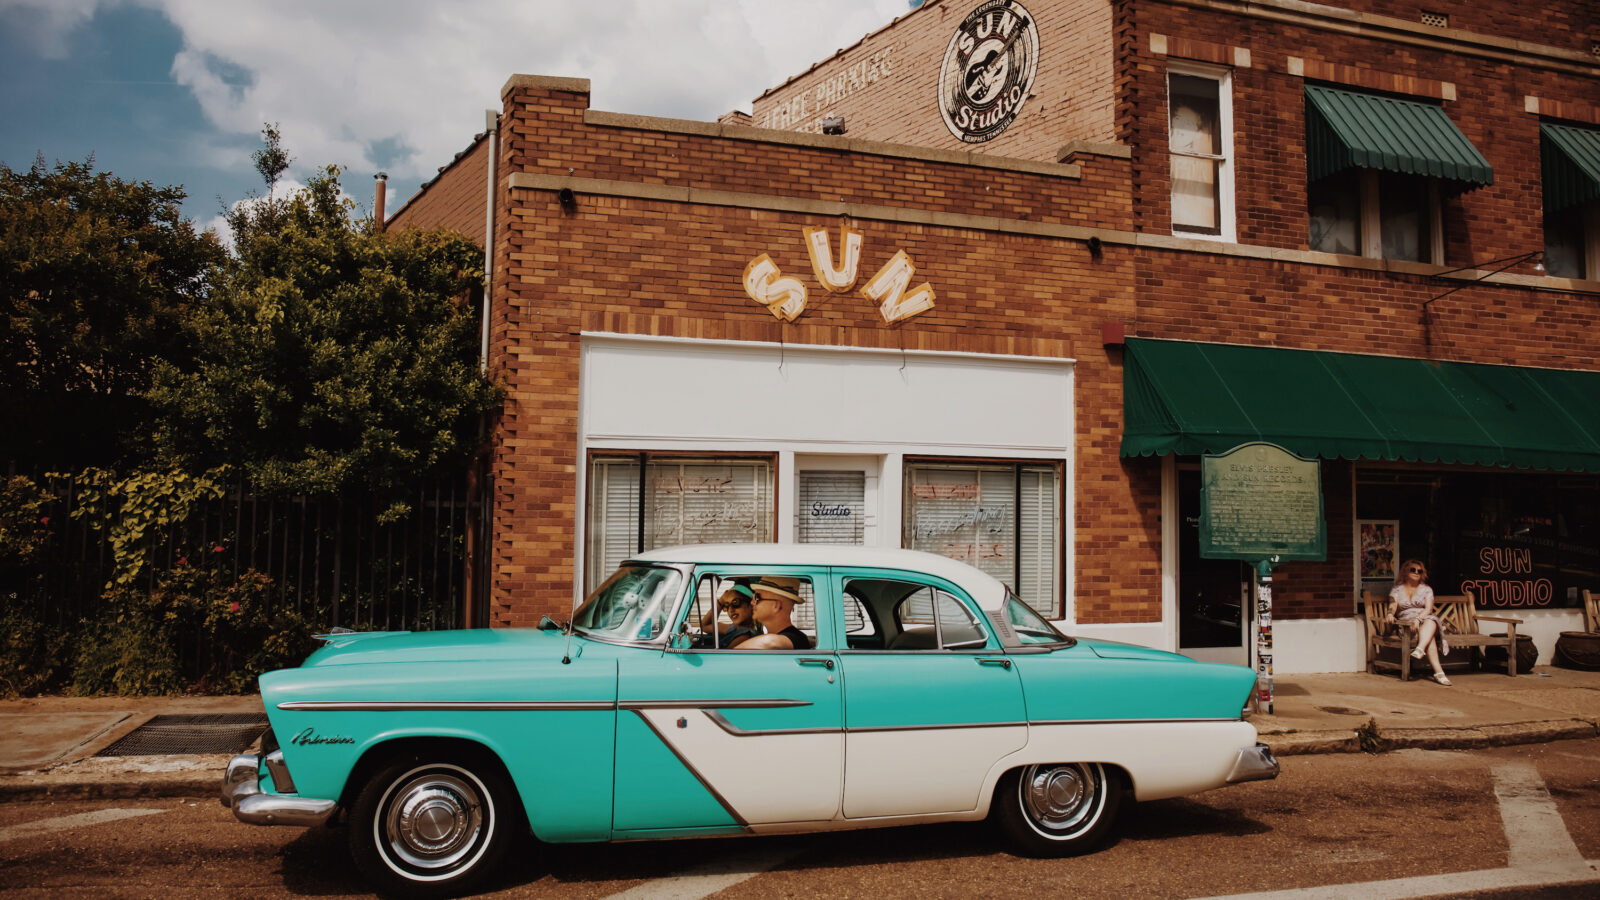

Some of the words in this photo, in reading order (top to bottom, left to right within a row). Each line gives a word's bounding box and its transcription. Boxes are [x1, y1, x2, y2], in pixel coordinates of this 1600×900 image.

[965, 12, 976, 23] THE
[959, 11, 1018, 55] SUN
[955, 85, 1021, 131] Studio
[742, 225, 937, 324] SUN
[811, 501, 852, 517] Studio
[1479, 547, 1532, 574] SUN
[1461, 578, 1553, 606] STUDIO
